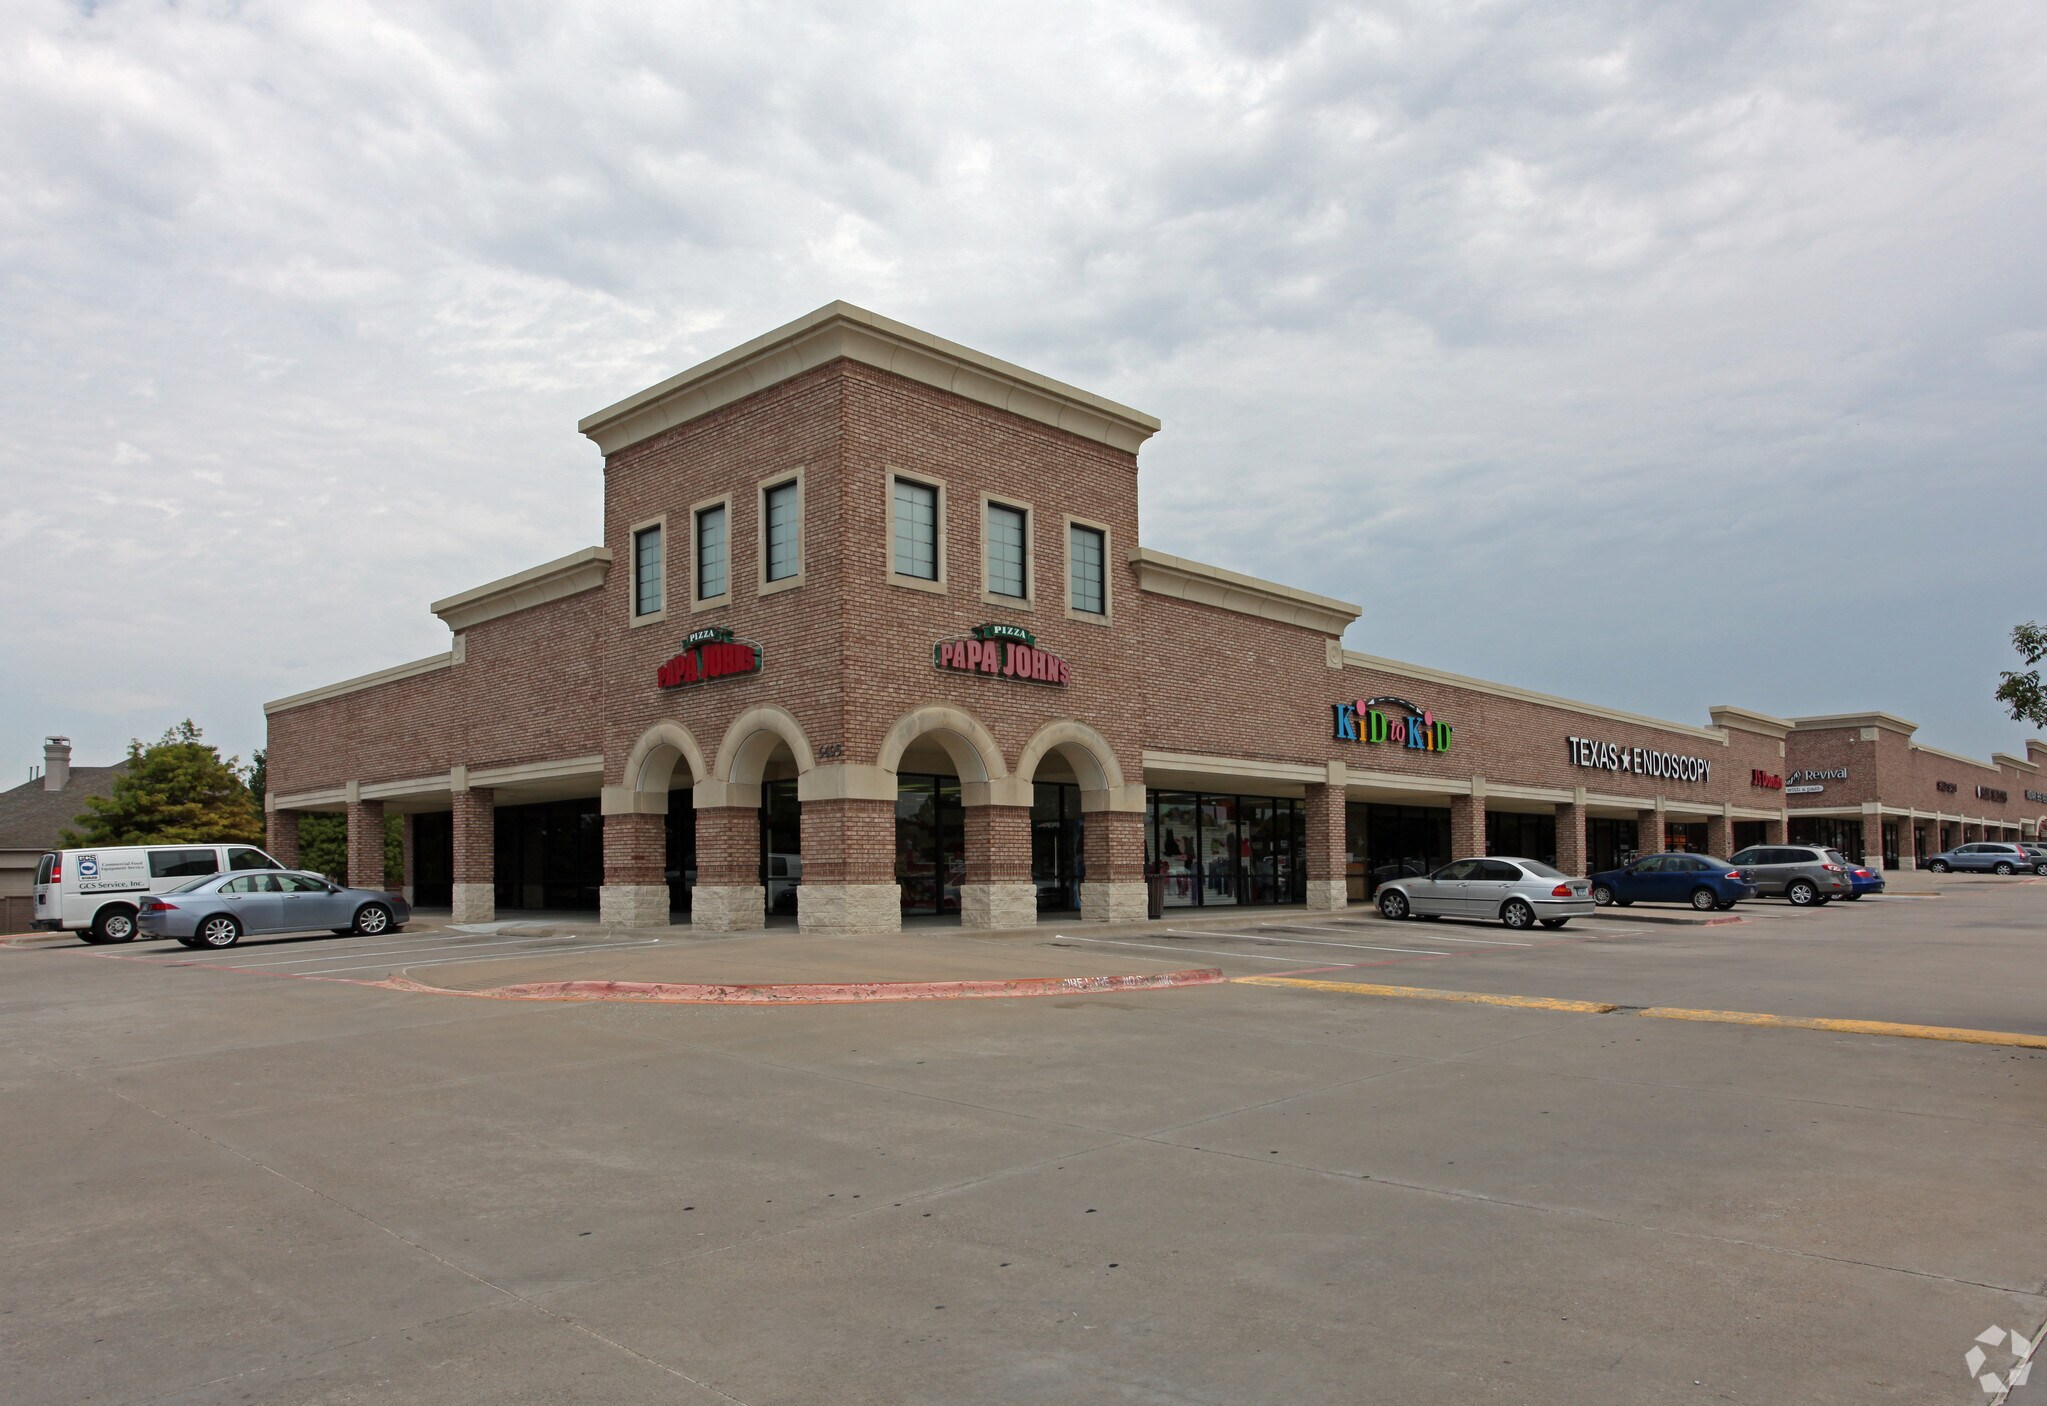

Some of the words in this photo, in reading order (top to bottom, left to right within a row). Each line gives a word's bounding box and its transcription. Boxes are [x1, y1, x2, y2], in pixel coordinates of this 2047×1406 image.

[690, 629, 715, 642] PIZZA
[994, 625, 1026, 639] PIZZA
[940, 640, 999, 674] PAPA
[657, 649, 698, 688] PAPA
[1390, 720, 1406, 742] to
[1568, 736, 1618, 771] TEXAS
[1633, 747, 1711, 783] ENDOSCOPY
[1805, 767, 1848, 781] Revival
[77, 854, 97, 862] GCS
[79, 882, 97, 890] GCS
[98, 881, 128, 889] Service,
